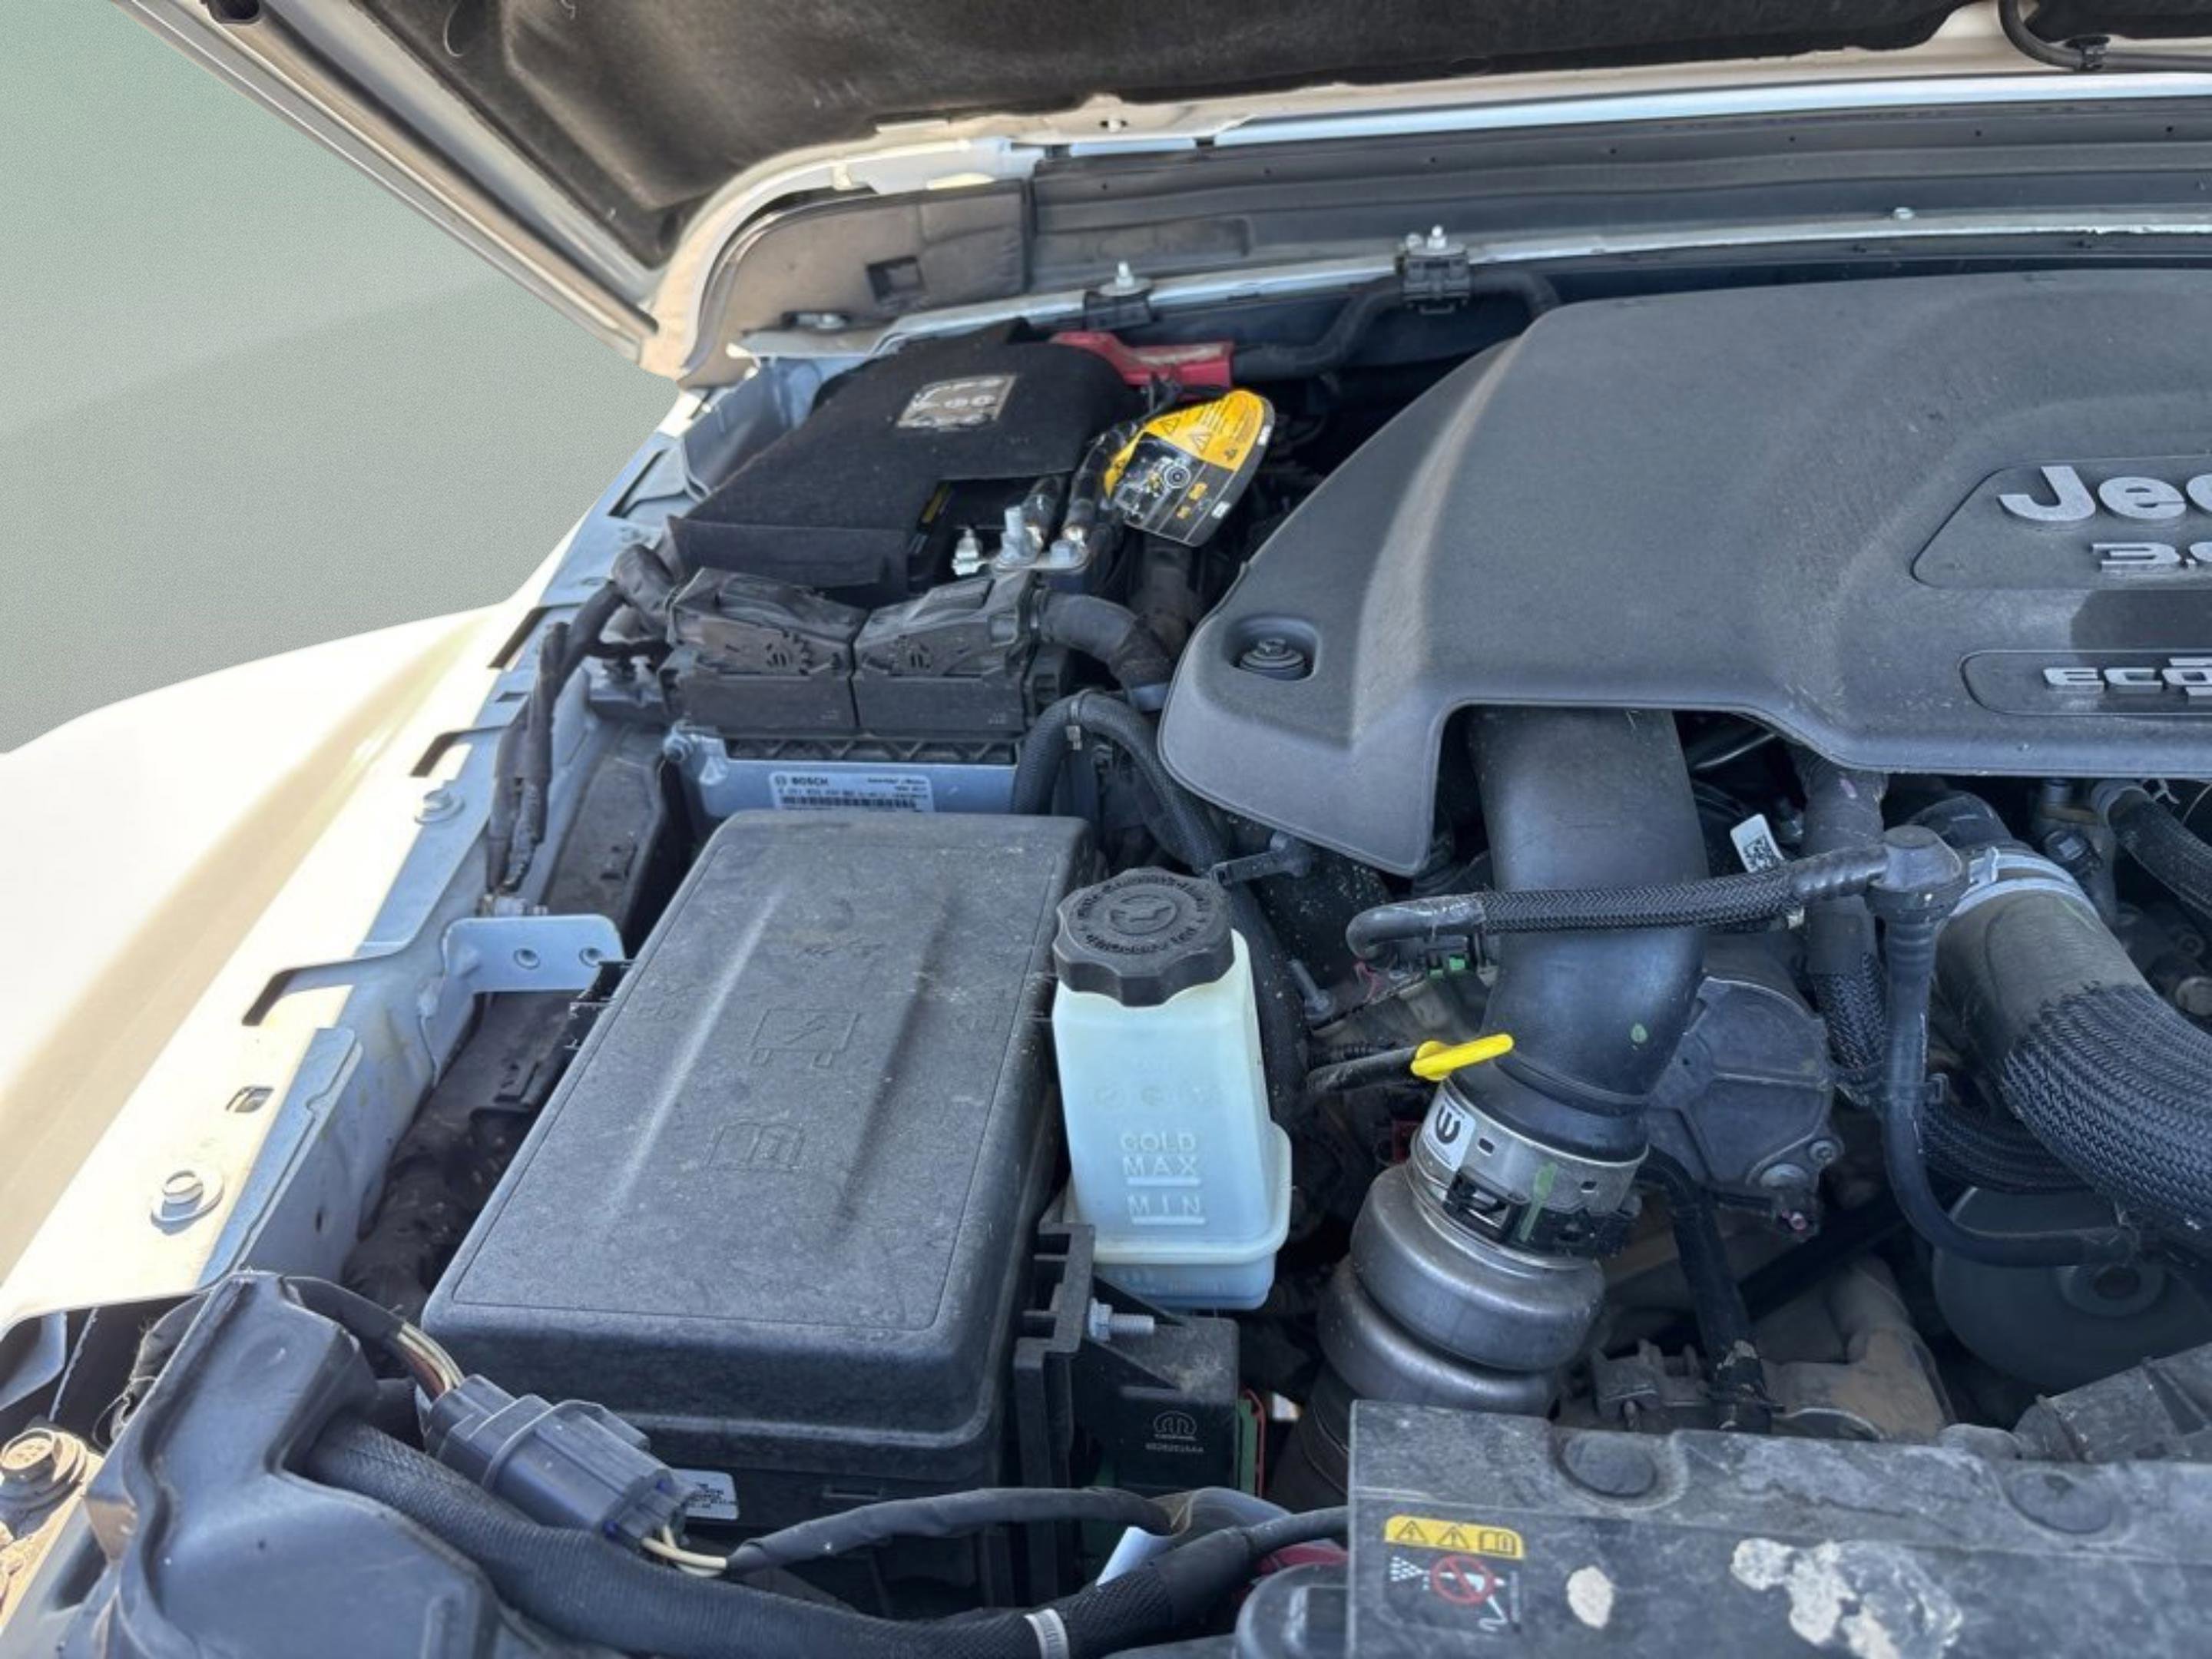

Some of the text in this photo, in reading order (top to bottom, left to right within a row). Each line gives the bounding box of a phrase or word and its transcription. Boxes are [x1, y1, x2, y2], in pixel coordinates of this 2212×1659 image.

[2091, 541, 2212, 566] 3.
[791, 777, 830, 786] BOSCH
[1122, 1154, 1197, 1177] MAX
[1126, 1194, 1200, 1215] MIN
